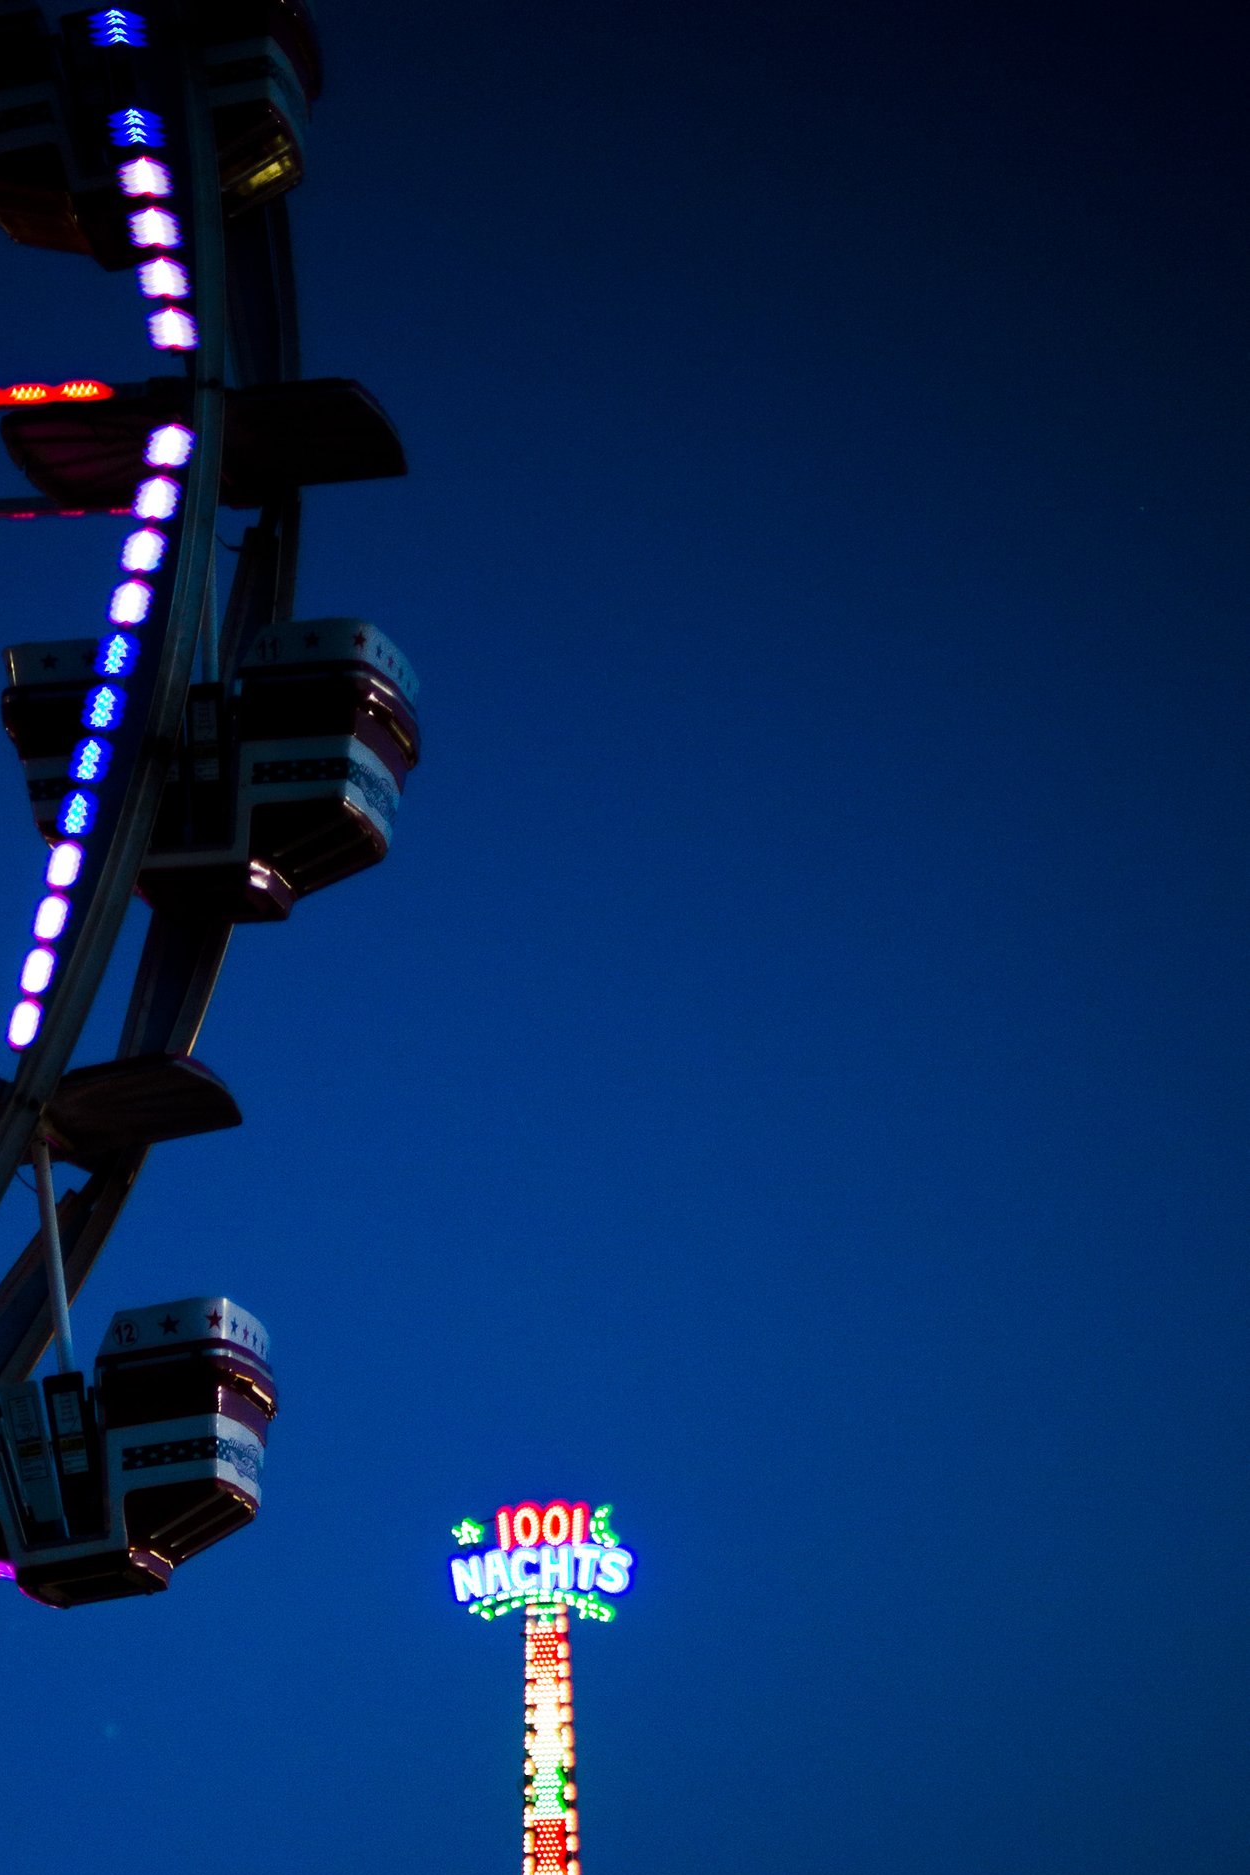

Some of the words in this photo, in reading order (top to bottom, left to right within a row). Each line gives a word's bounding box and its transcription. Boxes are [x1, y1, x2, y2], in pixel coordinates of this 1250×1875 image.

[114, 1322, 136, 1346] 12
[497, 1504, 587, 1550] 1001
[450, 1545, 631, 1602] NACHTS
